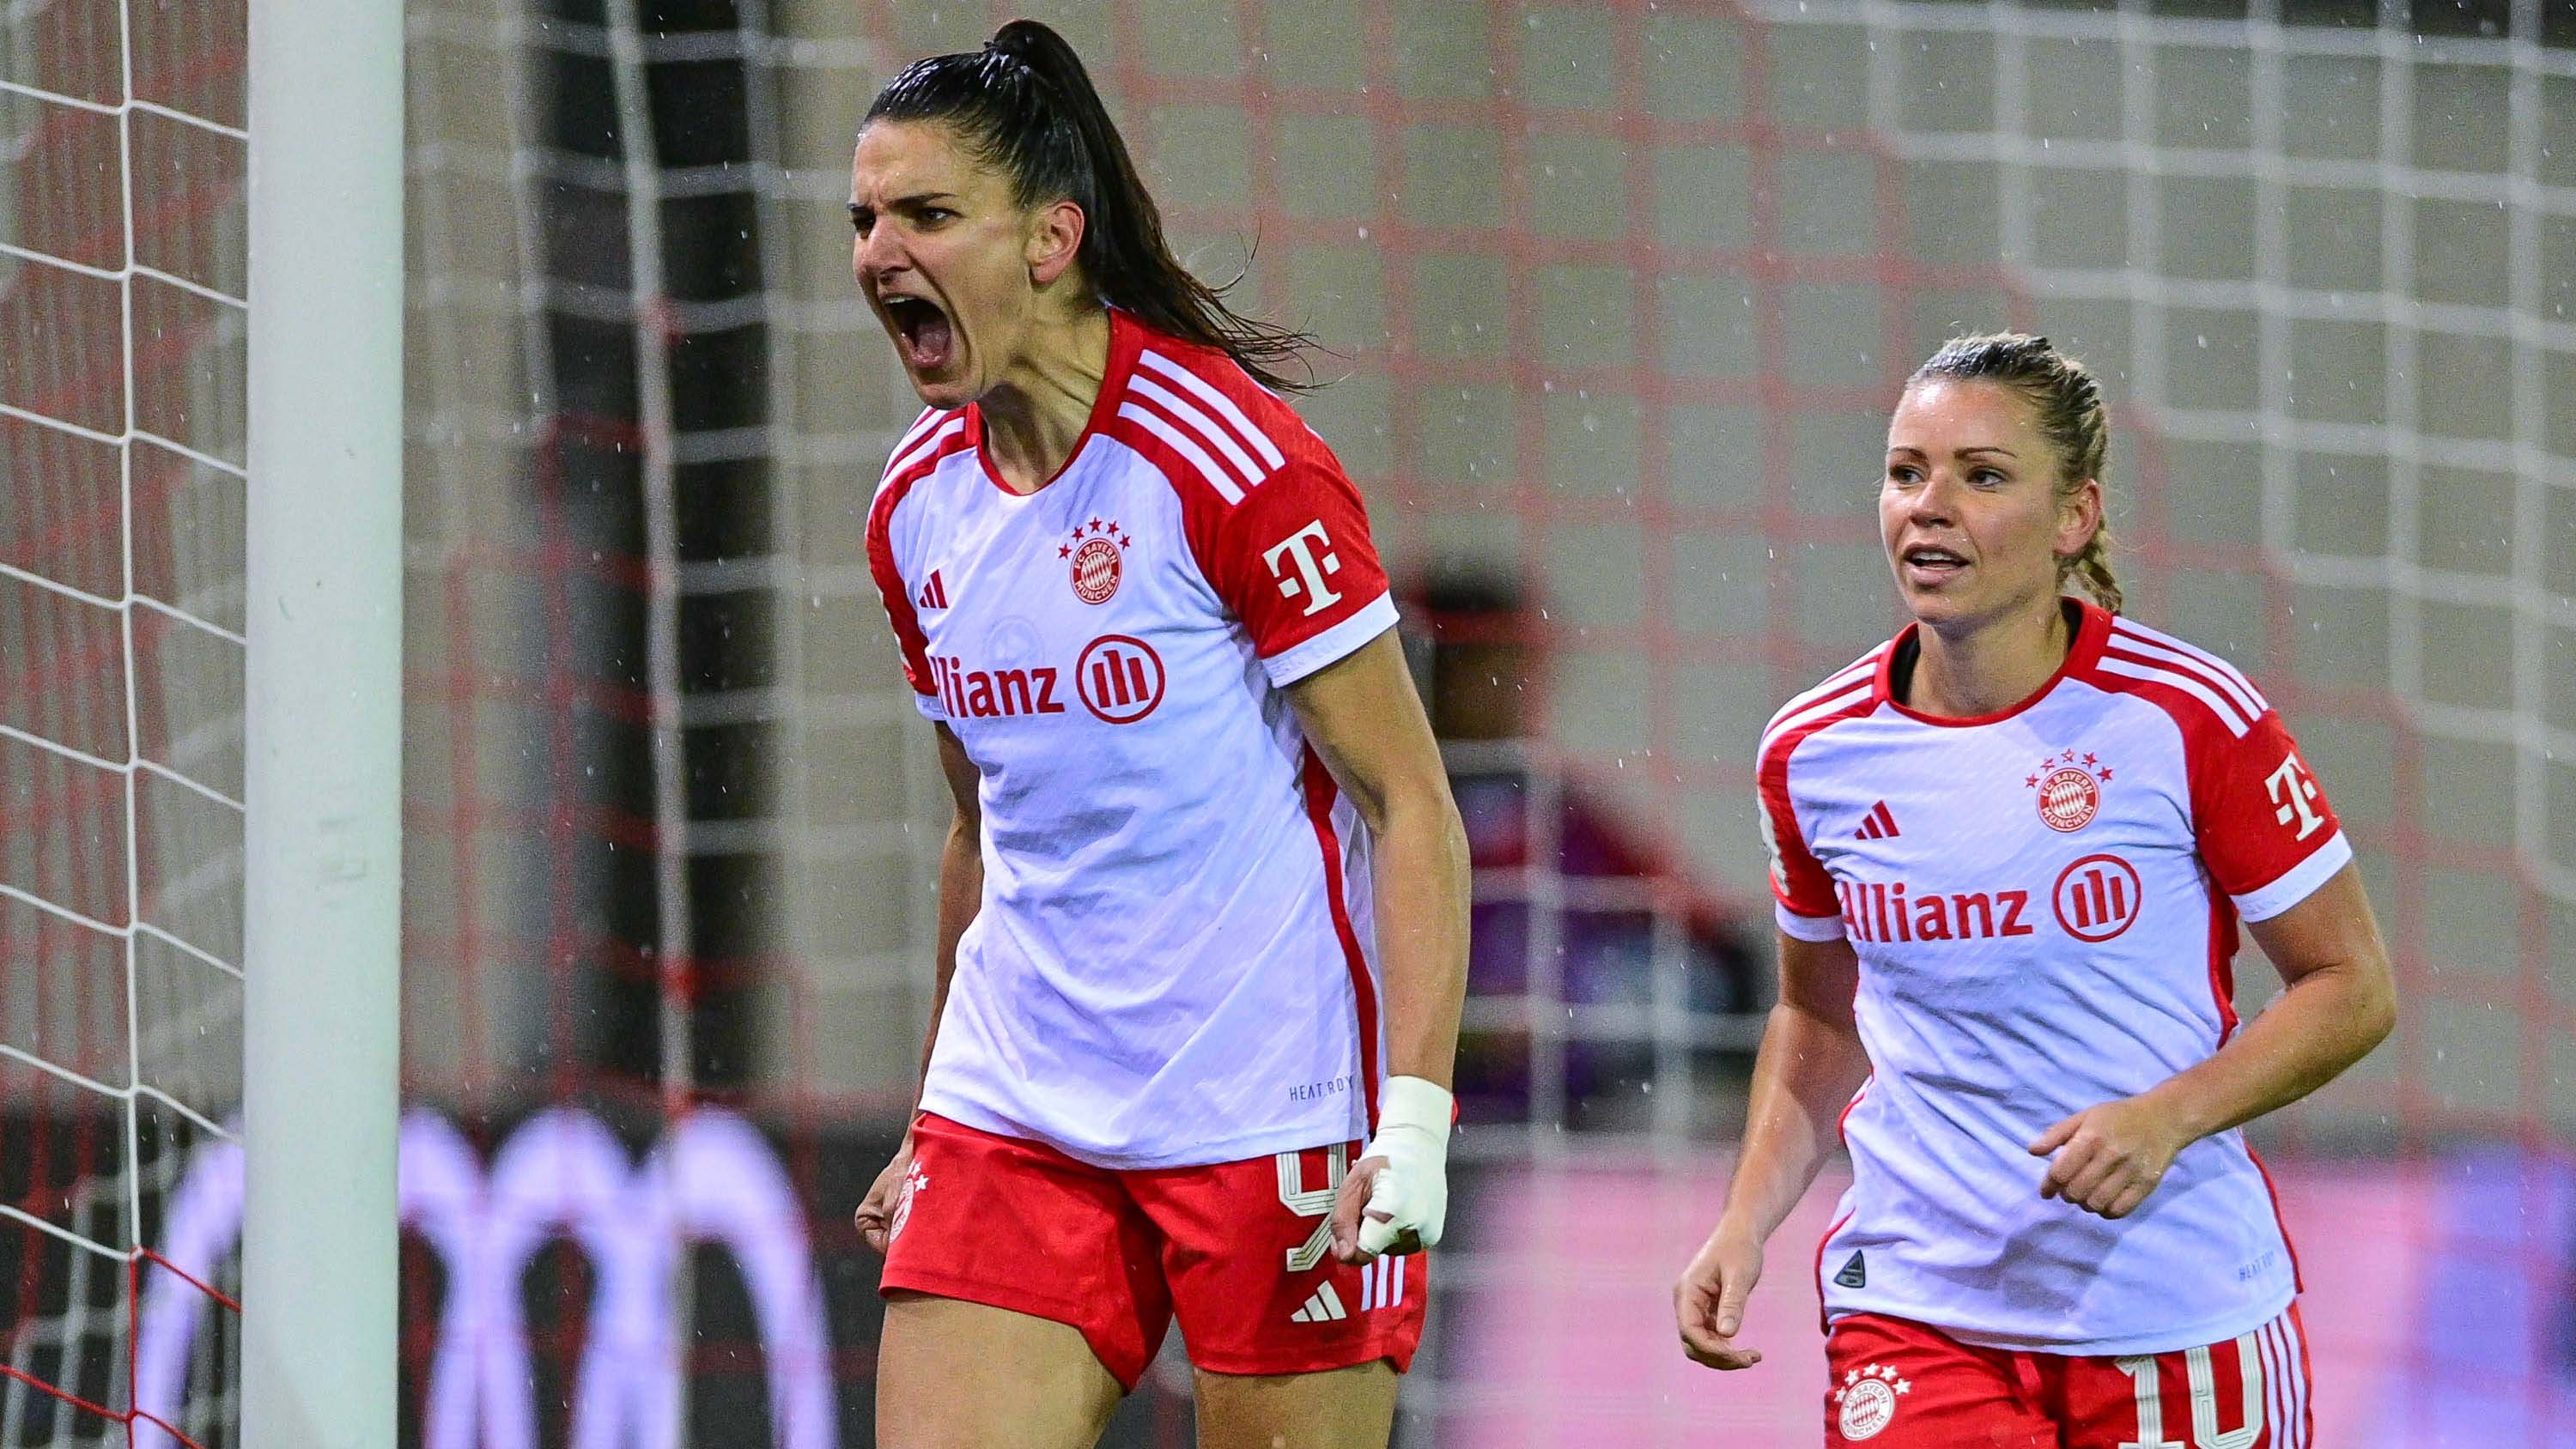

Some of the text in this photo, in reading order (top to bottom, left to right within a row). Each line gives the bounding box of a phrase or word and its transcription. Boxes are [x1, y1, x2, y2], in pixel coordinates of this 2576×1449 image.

[1074, 543, 1118, 569] FC BAYERN
[1261, 518, 1342, 616] T
[929, 656, 1065, 718] llianz
[2054, 772, 2093, 794] BAYERN
[2264, 750, 2324, 841] T
[1841, 881, 2033, 943] Allianz
[1276, 1143, 1346, 1271] 9
[2114, 1331, 2263, 1449] 10
